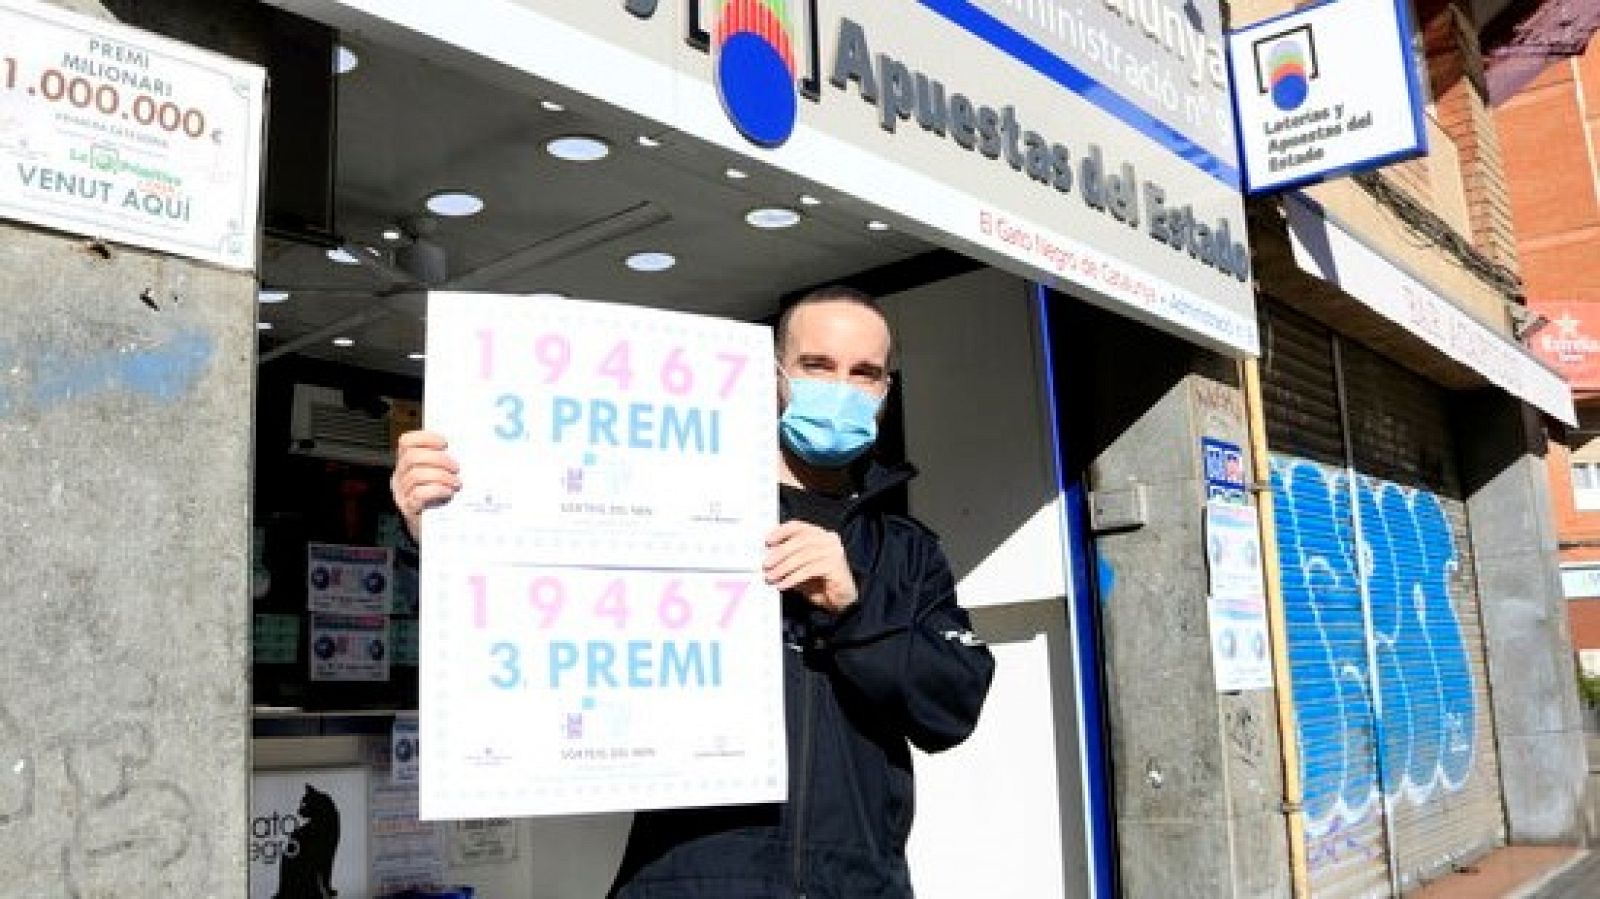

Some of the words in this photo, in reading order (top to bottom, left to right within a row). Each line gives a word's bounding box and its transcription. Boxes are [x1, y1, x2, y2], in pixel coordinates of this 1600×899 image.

[62, 51, 173, 97] MILIONARI
[89, 39, 149, 68] PREMI
[3, 57, 205, 138] 1.000.000
[210, 127, 223, 144] €
[1346, 110, 1374, 131] del
[829, 17, 1072, 194] Apuestas
[1078, 143, 1138, 228] del
[1143, 180, 1249, 283] Estado
[18, 162, 113, 202] VENUT
[979, 208, 993, 236] El
[997, 216, 1033, 252] Gato
[552, 395, 720, 455] PREMI
[549, 639, 723, 688] PREMI
